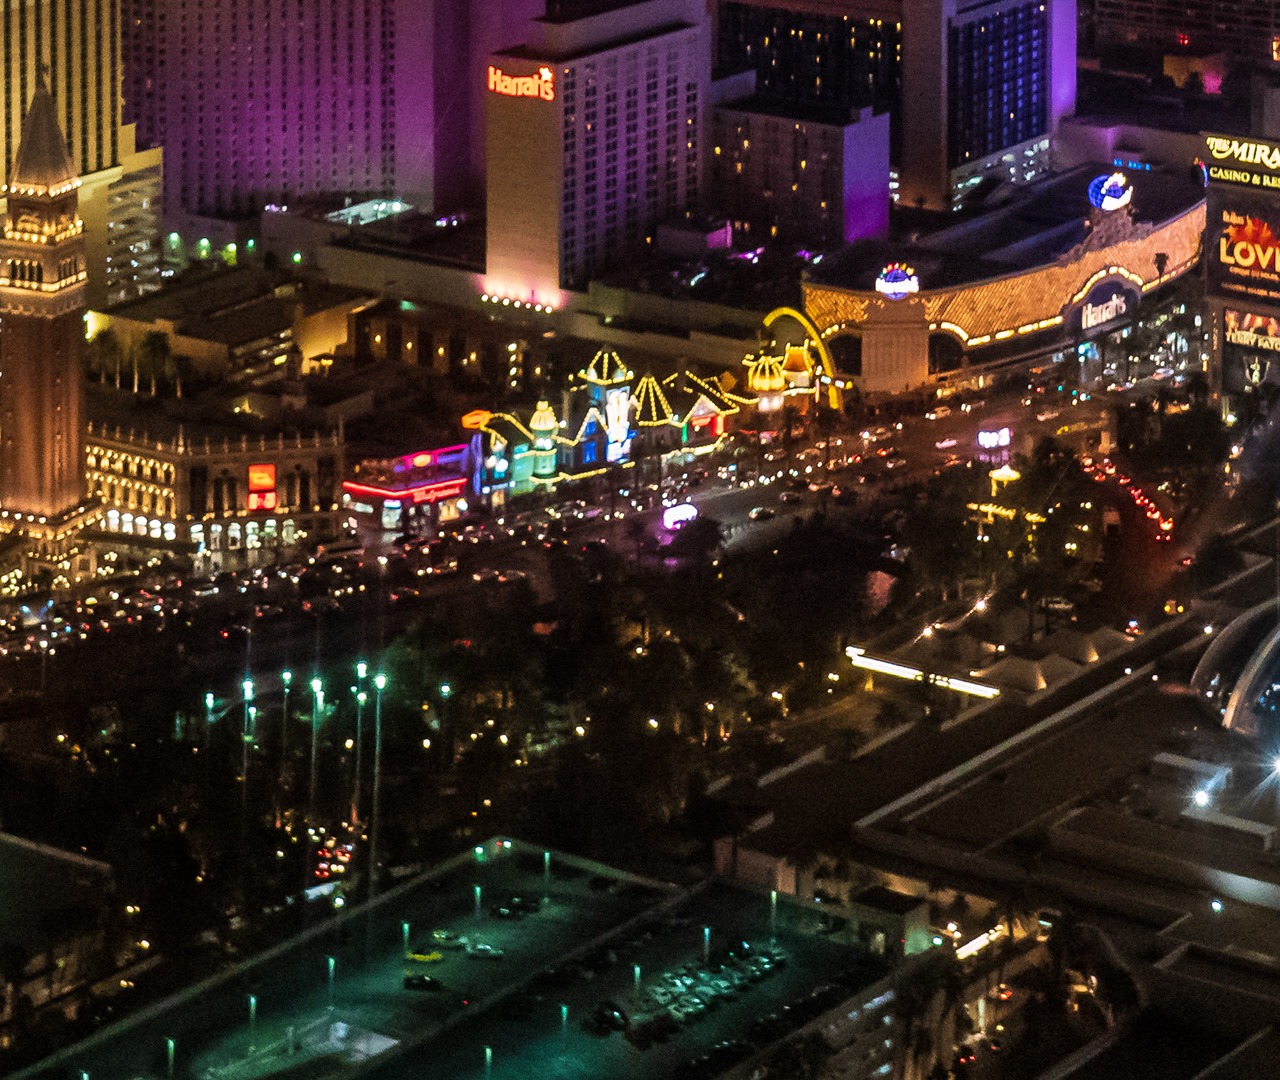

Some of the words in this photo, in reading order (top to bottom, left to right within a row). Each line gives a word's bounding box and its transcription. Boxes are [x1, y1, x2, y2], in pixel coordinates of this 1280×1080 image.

[488, 66, 555, 101] Harrah's
[1209, 166, 1250, 183] CASINO
[1251, 175, 1260, 185] &
[1081, 293, 1126, 330] Harrah's
[413, 486, 462, 504] Walgreens
